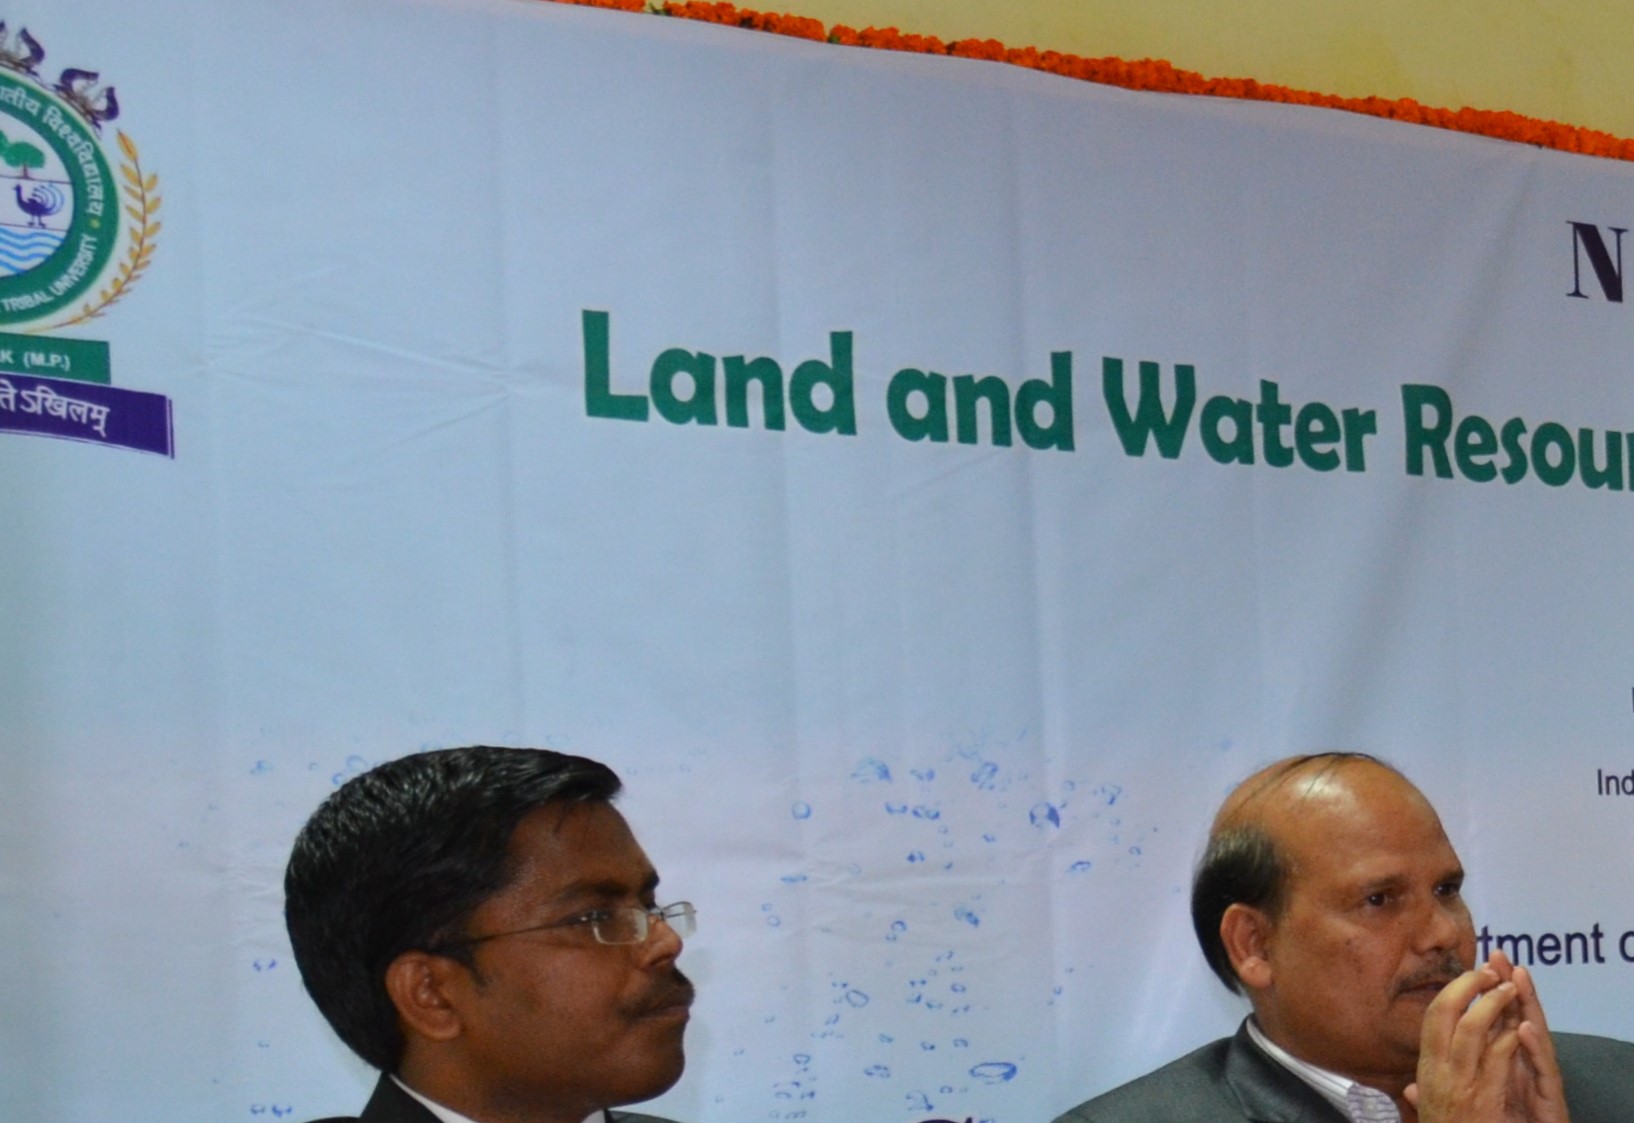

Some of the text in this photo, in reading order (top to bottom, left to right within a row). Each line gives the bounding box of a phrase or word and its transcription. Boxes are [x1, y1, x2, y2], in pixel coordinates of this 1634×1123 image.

[1, 232, 99, 313] TRIBAL UNIVERSITY
[23, 351, 71, 372] (M.P.)
[582, 308, 858, 438] Land
[886, 350, 1076, 453] and
[1102, 355, 1378, 474] Water
[1475, 921, 1606, 968] tment
